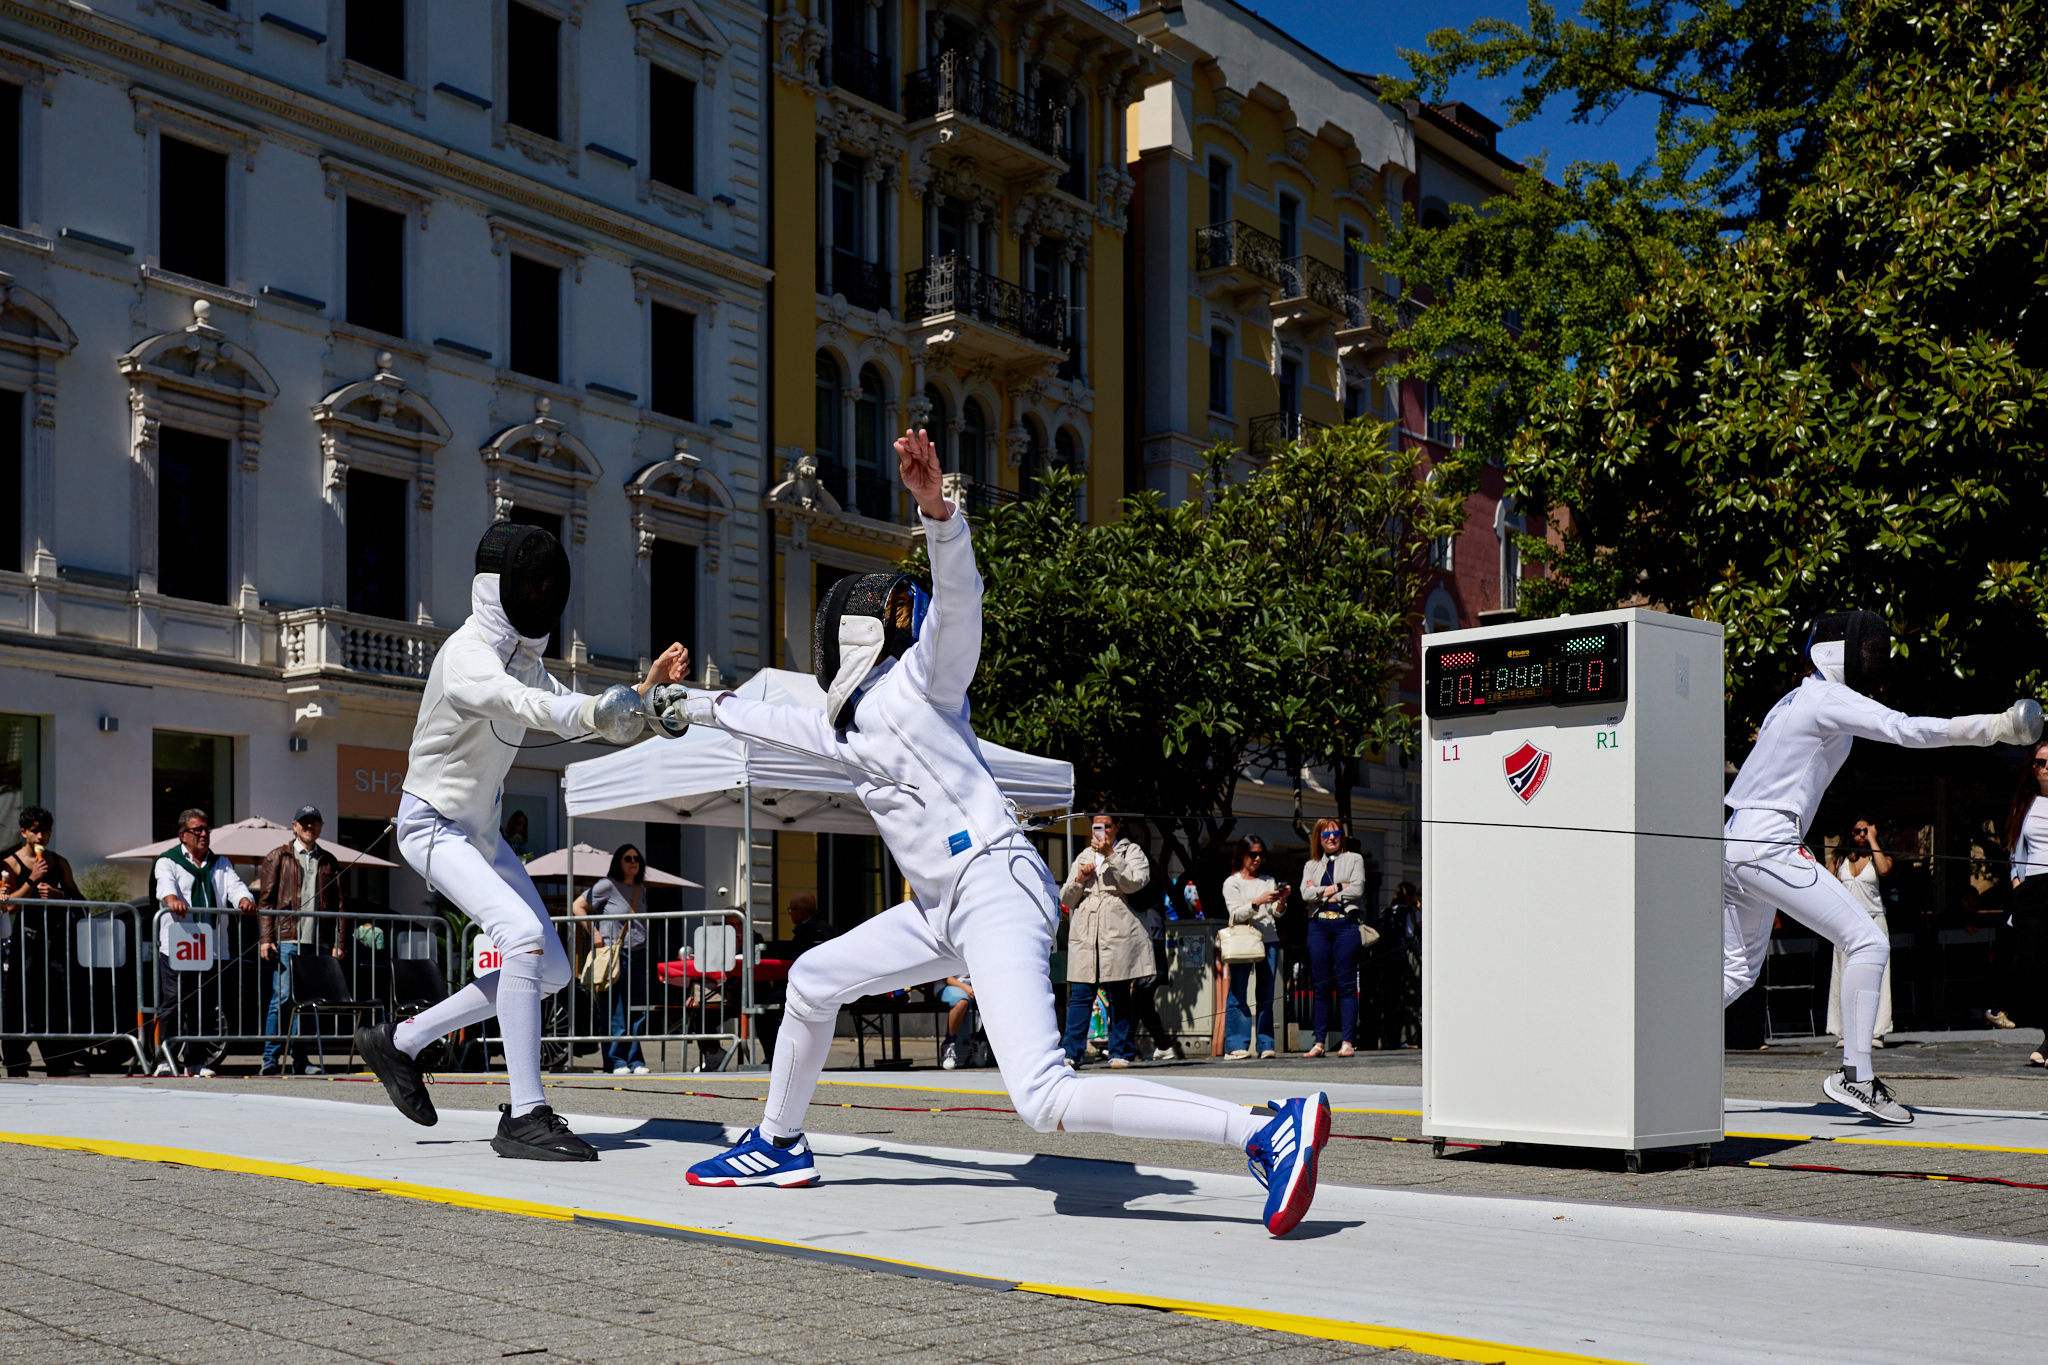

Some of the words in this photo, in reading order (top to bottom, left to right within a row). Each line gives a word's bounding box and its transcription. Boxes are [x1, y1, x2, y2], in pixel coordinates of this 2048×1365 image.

[1597, 730, 1619, 750] R1
[1442, 744, 1461, 762] L1
[1525, 781, 1541, 798] LUGANO
[176, 932, 206, 961] ail
